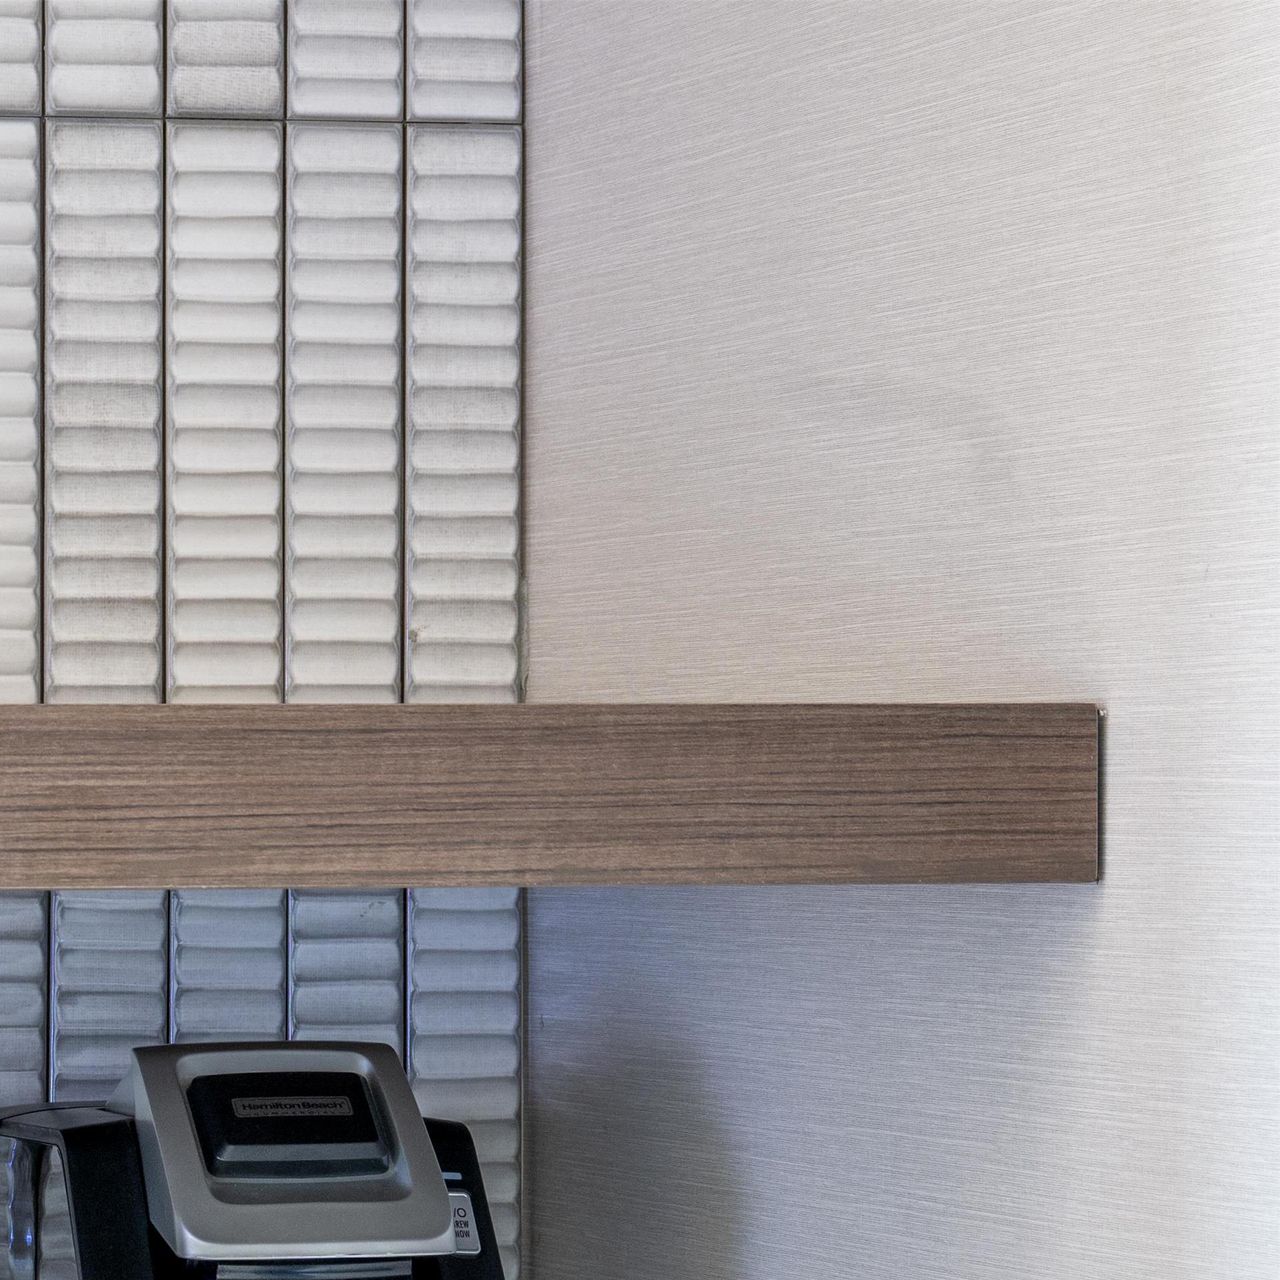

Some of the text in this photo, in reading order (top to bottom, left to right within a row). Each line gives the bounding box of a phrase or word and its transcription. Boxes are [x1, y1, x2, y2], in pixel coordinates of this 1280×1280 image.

[242, 1101, 344, 1110] Hamilton Beach
[454, 1220, 468, 1228] REW
